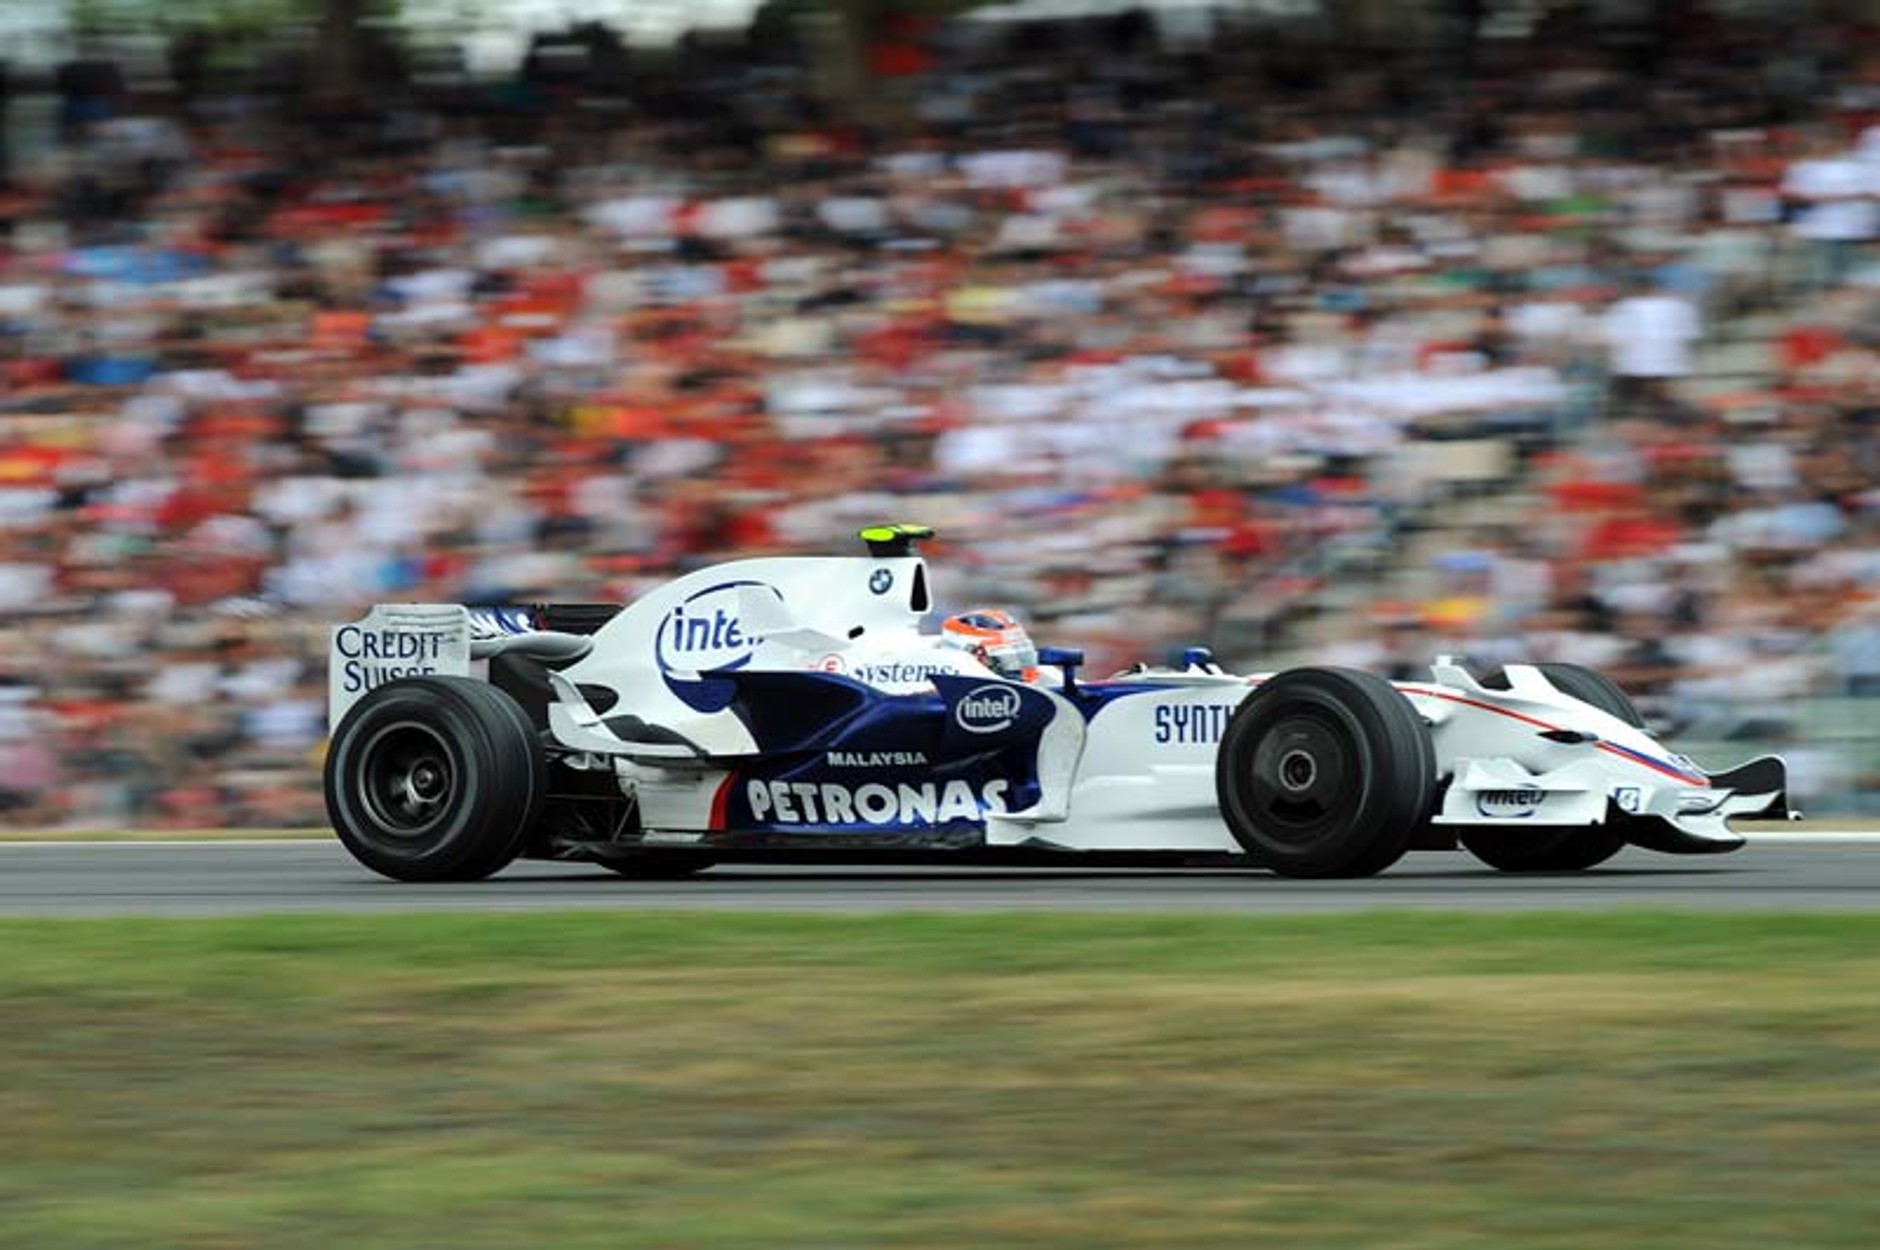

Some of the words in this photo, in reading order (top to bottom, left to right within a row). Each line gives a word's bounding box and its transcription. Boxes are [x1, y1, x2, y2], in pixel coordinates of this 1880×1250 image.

[336, 627, 443, 660] CREDIT
[674, 606, 753, 652] inte
[964, 695, 1010, 718] intel
[828, 751, 926, 766] MALAYSIA
[748, 779, 1008, 824] PETRONAS
